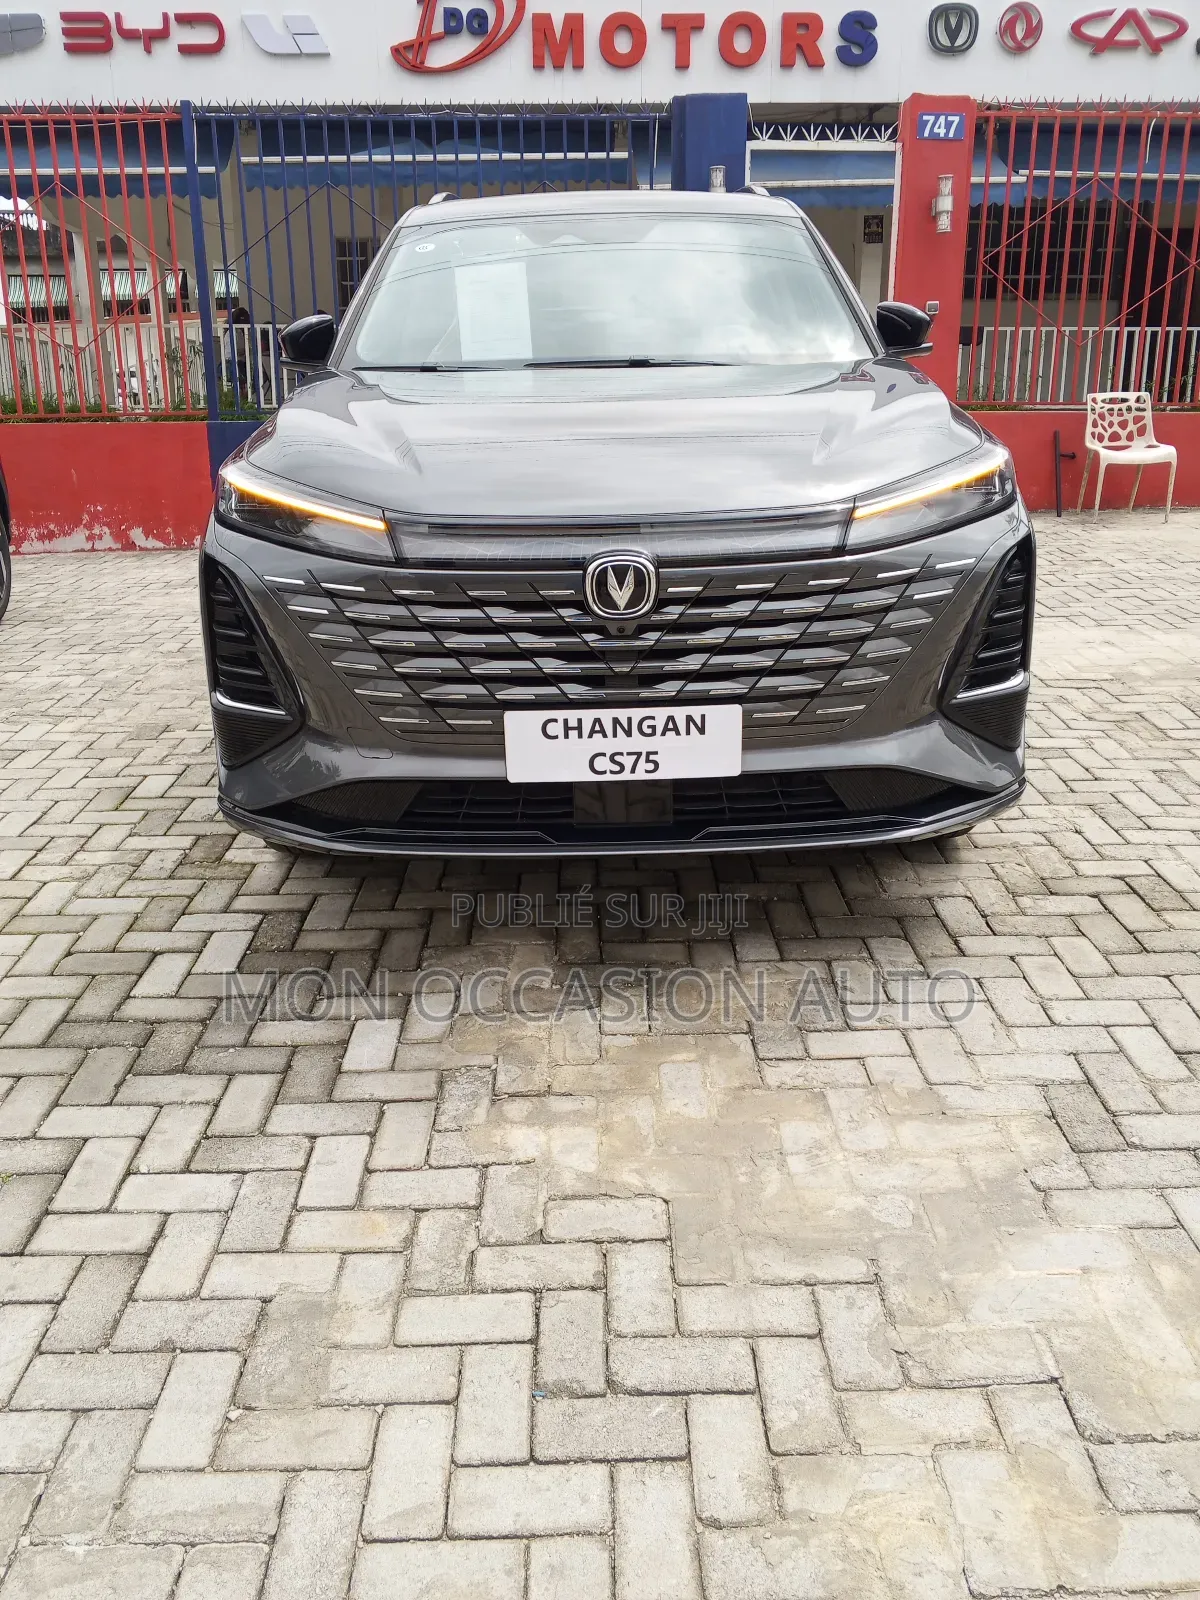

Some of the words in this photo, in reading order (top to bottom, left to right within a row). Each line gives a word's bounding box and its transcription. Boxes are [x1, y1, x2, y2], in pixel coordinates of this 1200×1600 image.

[532, 10, 878, 70] MOTORS
[922, 115, 960, 137] 747
[541, 714, 706, 740] CHANGAN
[588, 751, 660, 775] CS75
